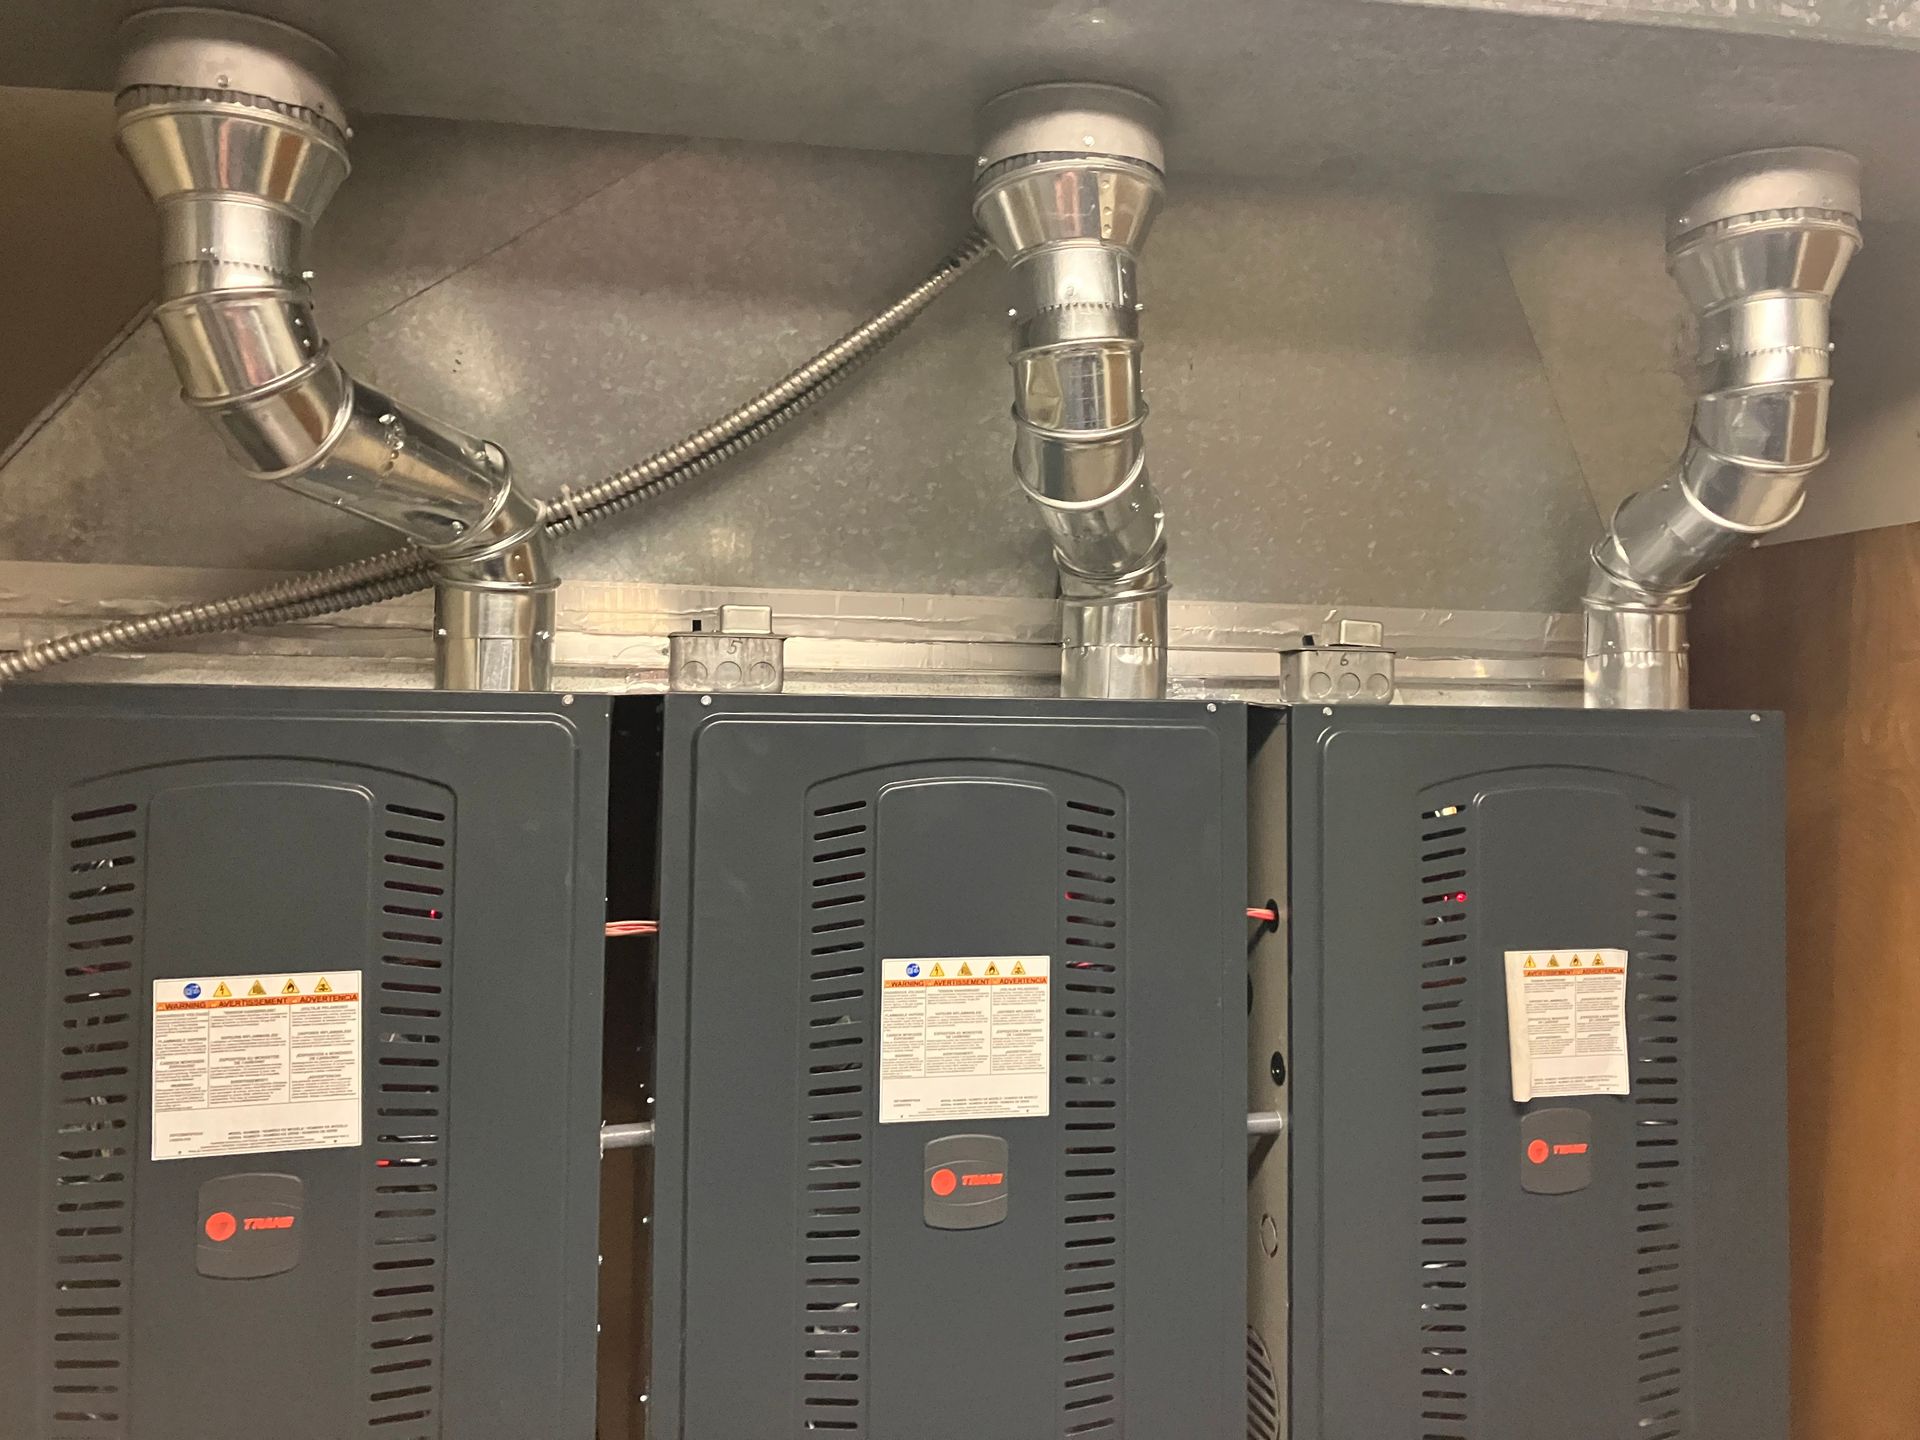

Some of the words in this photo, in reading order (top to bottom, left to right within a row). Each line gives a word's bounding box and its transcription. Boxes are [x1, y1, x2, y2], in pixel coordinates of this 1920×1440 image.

[727, 639, 743, 655] 5
[1340, 652, 1350, 666] 6
[933, 978, 990, 986] AVERTISSEMENT
[999, 976, 1047, 985] ADVERTENCIA
[165, 1001, 206, 1010] WARNING
[218, 997, 288, 1007] AVERTISSEMENT
[300, 994, 358, 1003] ADVERTENCIA
